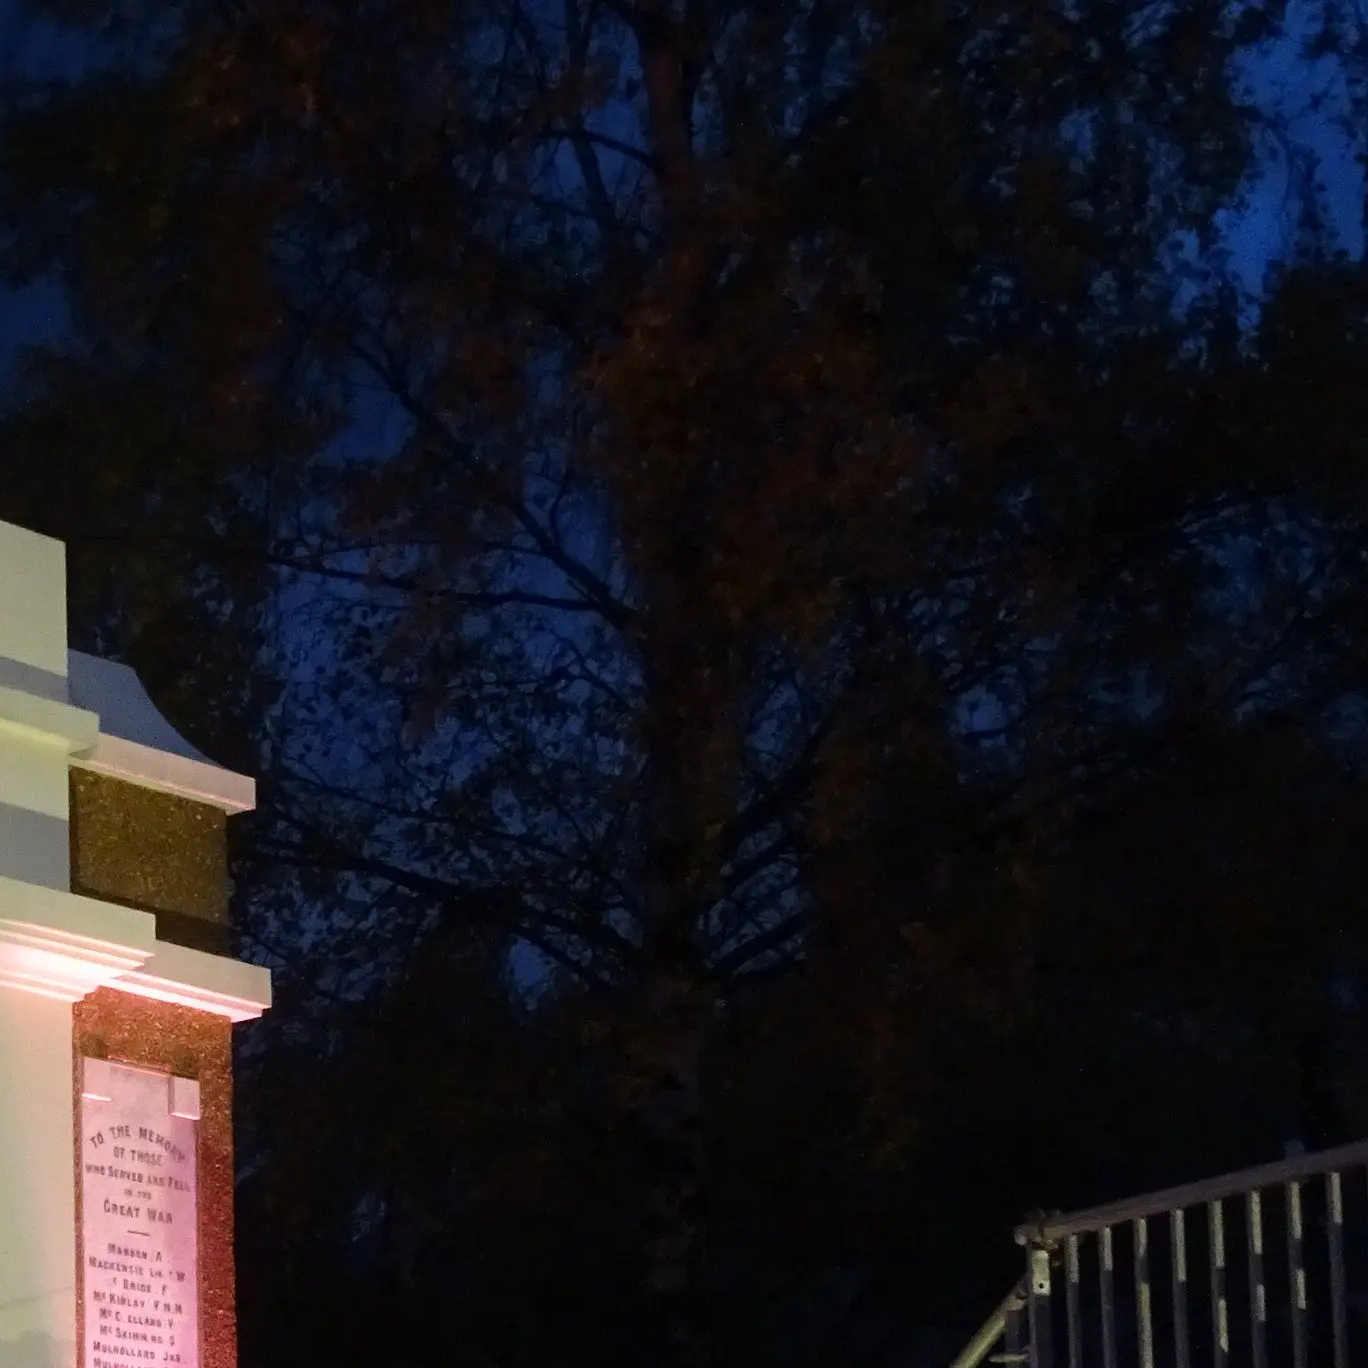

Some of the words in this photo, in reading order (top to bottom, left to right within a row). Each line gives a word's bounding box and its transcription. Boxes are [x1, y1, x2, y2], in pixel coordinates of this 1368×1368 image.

[89, 1131, 104, 1149] TO
[108, 1124, 132, 1140] THE
[113, 1145, 125, 1159] OF
[130, 1149, 163, 1166] THOSE
[103, 1197, 140, 1219] GREAT
[147, 1207, 173, 1224] WAR
